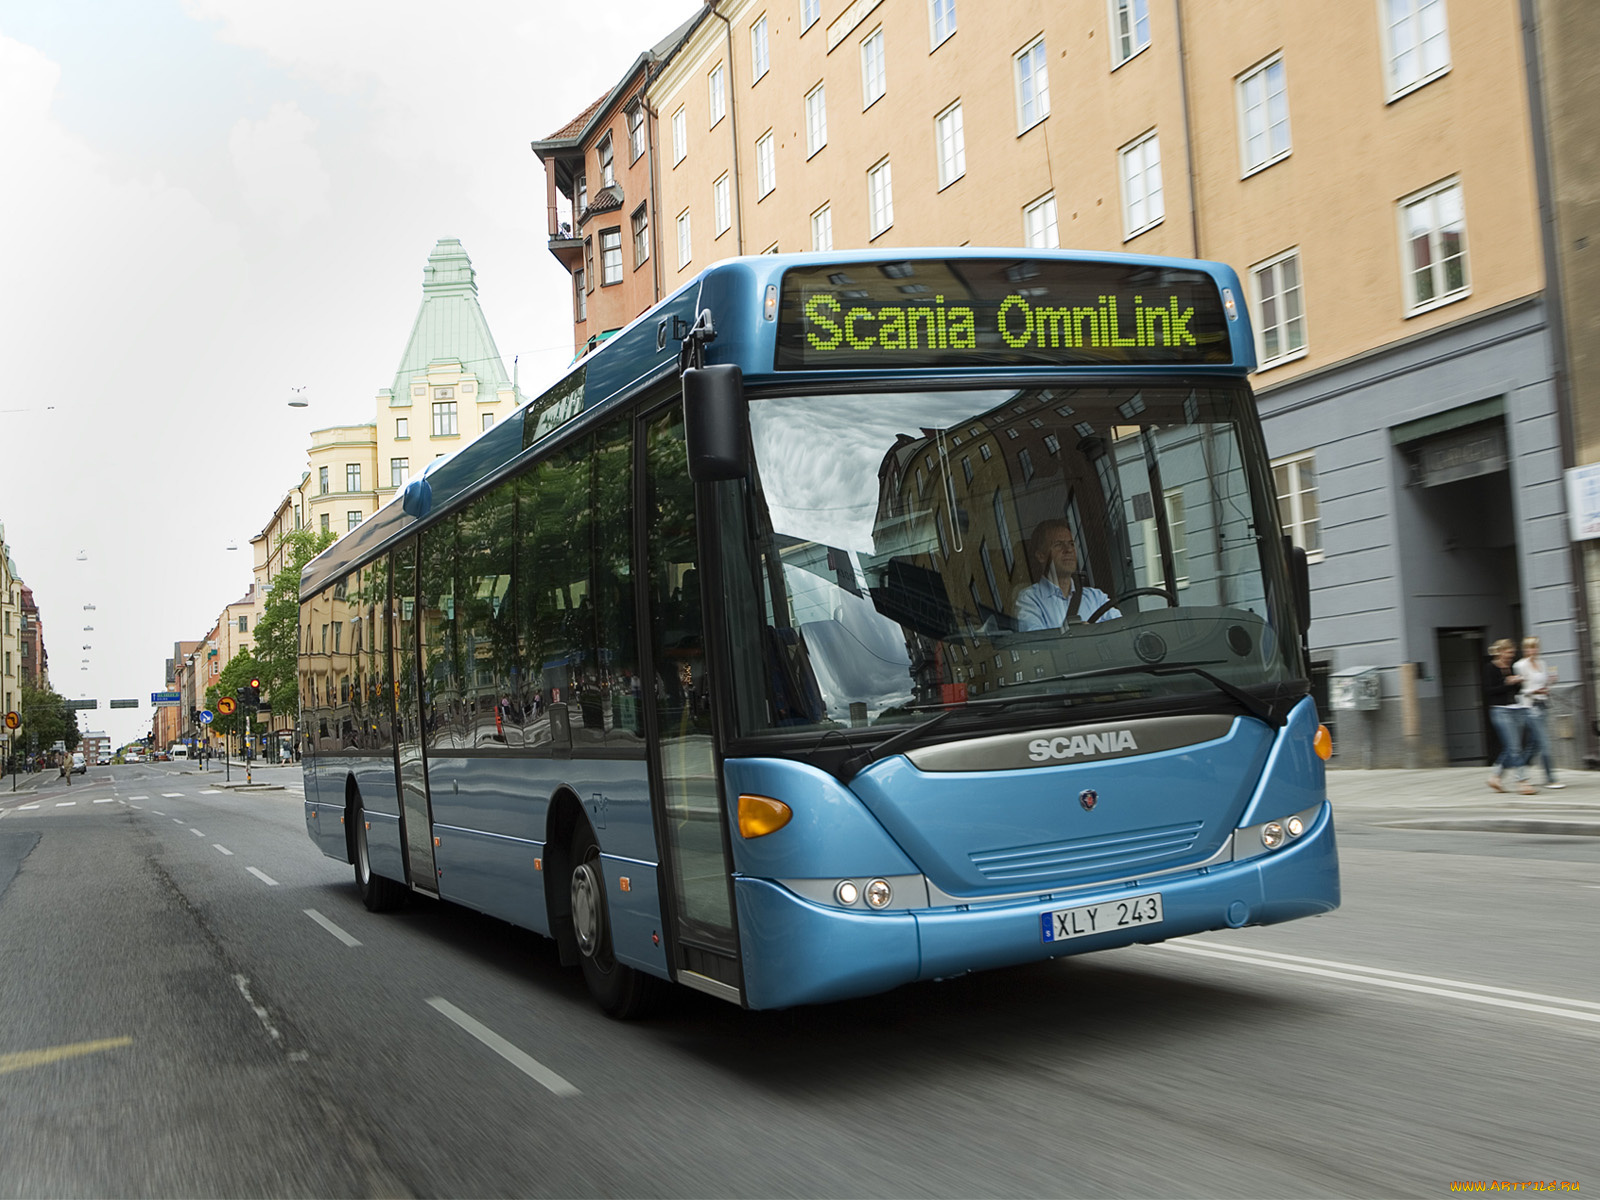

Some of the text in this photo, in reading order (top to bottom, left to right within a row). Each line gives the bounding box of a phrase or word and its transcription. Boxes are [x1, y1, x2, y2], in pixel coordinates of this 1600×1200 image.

[804, 294, 1197, 351] Scania OmniLink
[1028, 730, 1138, 761] SCANIA
[1056, 908, 1098, 937] XLY
[1116, 898, 1158, 926] 243
